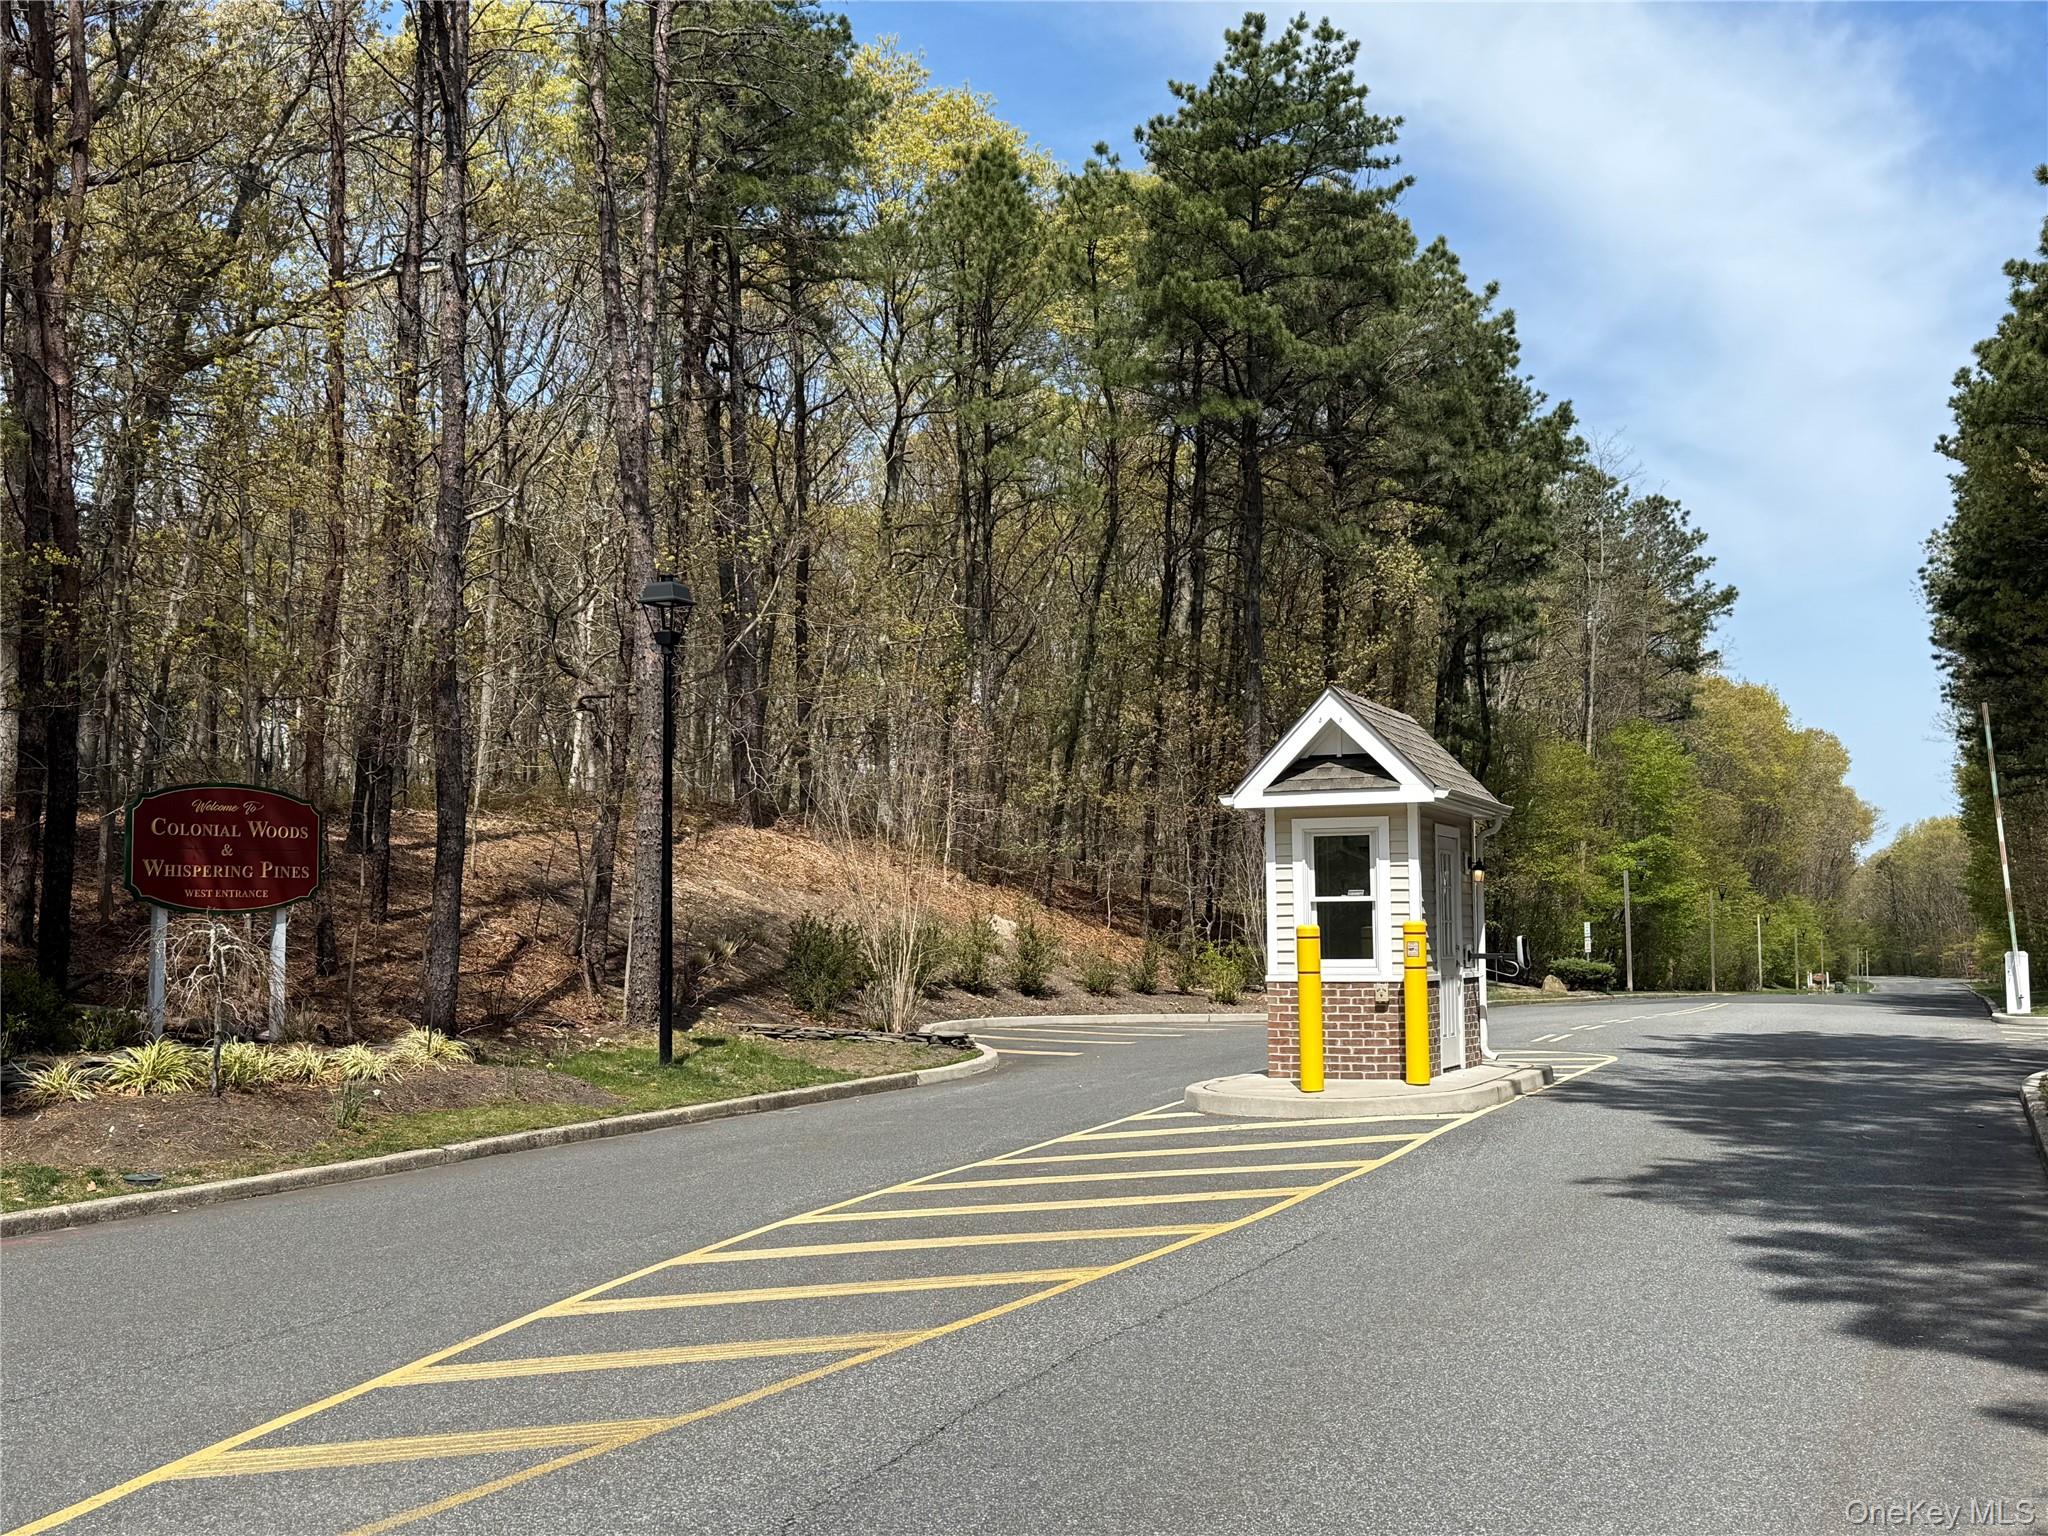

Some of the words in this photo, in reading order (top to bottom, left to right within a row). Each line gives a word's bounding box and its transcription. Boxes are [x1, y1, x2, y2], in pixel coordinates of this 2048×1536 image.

[191, 799, 239, 813] Welcome
[243, 800, 264, 814] To
[151, 817, 241, 837] COLONIAL
[248, 821, 309, 839] WOODS
[221, 843, 233, 856] &
[142, 859, 254, 878] WHISPERING
[260, 861, 310, 879] PINES
[184, 889, 213, 898] WEST
[215, 889, 269, 898] ENTRANCE
